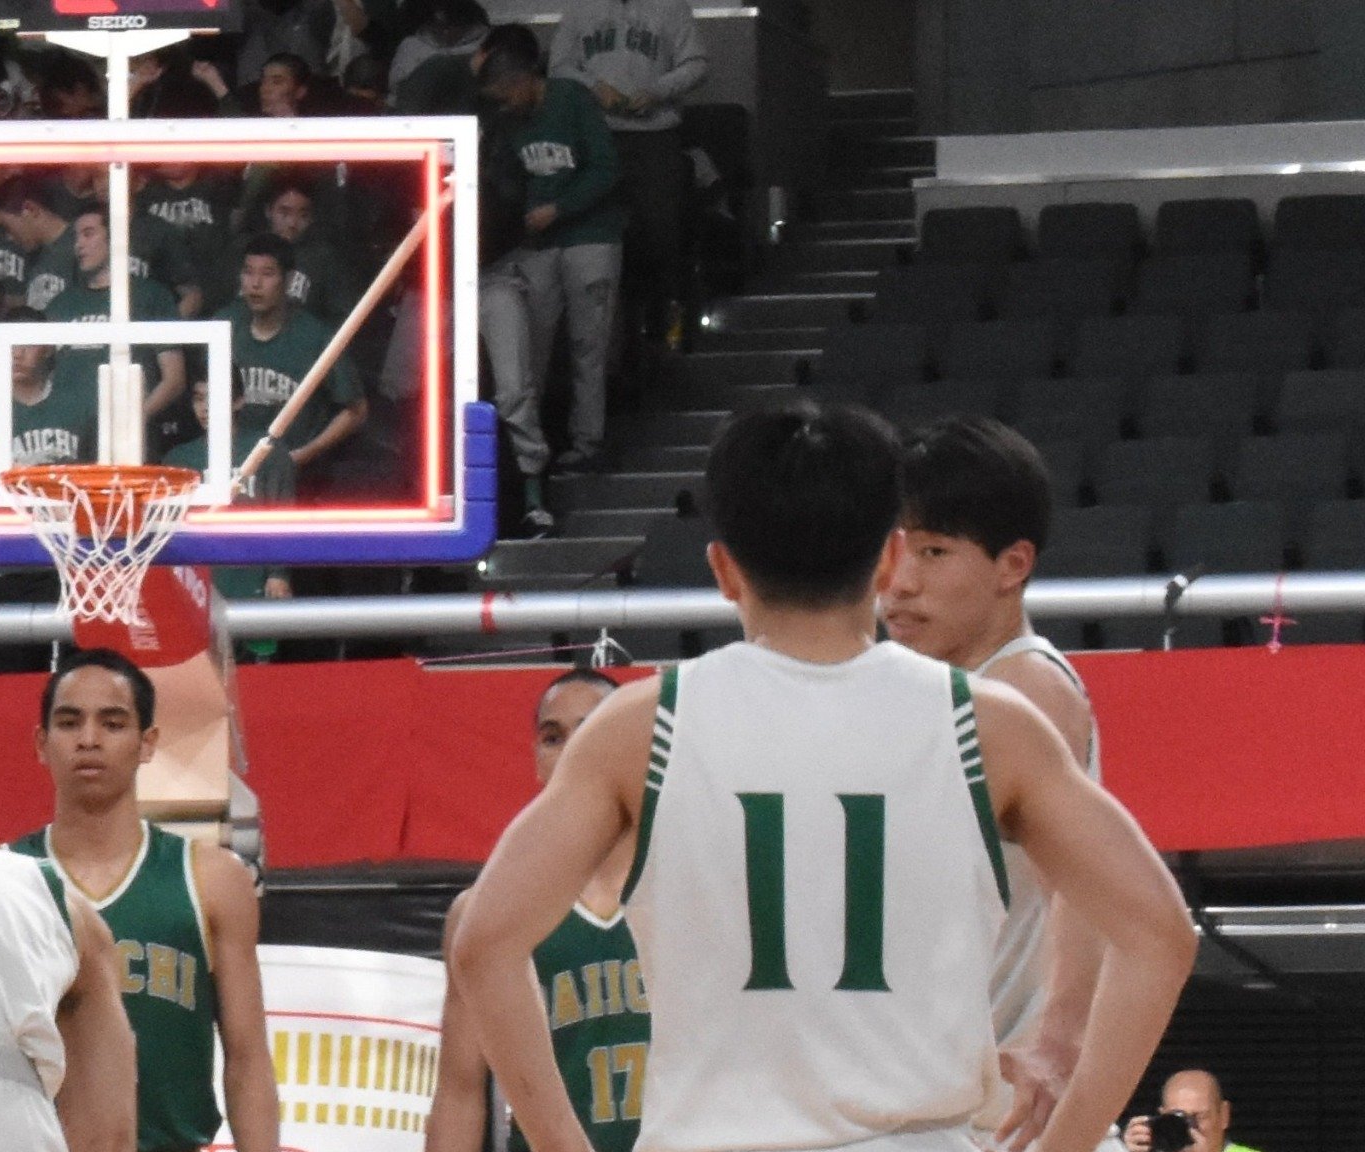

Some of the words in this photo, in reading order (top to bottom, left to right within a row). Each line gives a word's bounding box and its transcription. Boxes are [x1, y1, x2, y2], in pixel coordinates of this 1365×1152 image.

[88, 16, 147, 29] SEIKO
[735, 792, 893, 992] 11
[587, 1042, 650, 1124] 17
